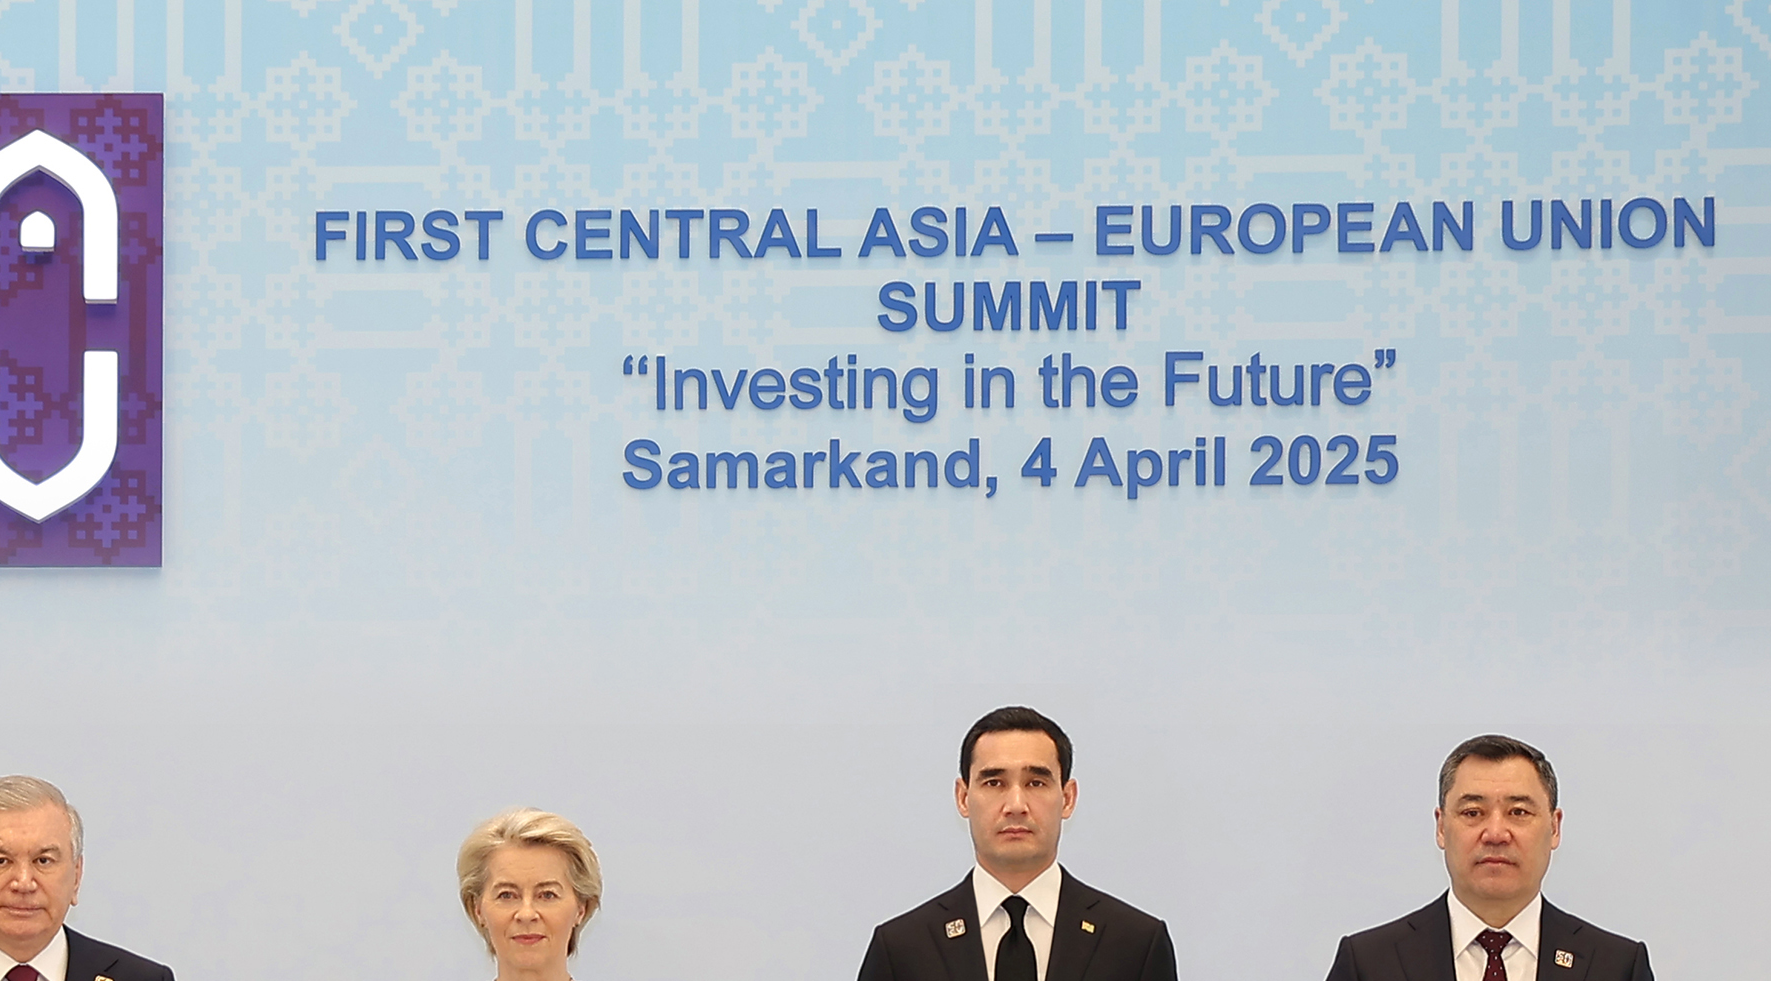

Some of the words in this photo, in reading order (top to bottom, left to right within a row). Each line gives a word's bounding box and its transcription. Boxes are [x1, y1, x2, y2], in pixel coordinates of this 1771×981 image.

[315, 209, 504, 262] FIRST
[525, 208, 842, 261] CENTRAL
[857, 206, 1019, 258] ASIA
[1096, 200, 1474, 257] EUROPEAN
[1501, 196, 1716, 252] UNION
[877, 280, 1142, 333] SUMMIT
[623, 354, 938, 424] “Investing
[964, 353, 1015, 409] in
[1038, 352, 1139, 409] the
[1164, 348, 1396, 407] Future”
[622, 438, 998, 499] Samarkand,
[1021, 437, 1058, 488] 4
[1074, 436, 1226, 500] April
[1249, 434, 1399, 486] 2025
